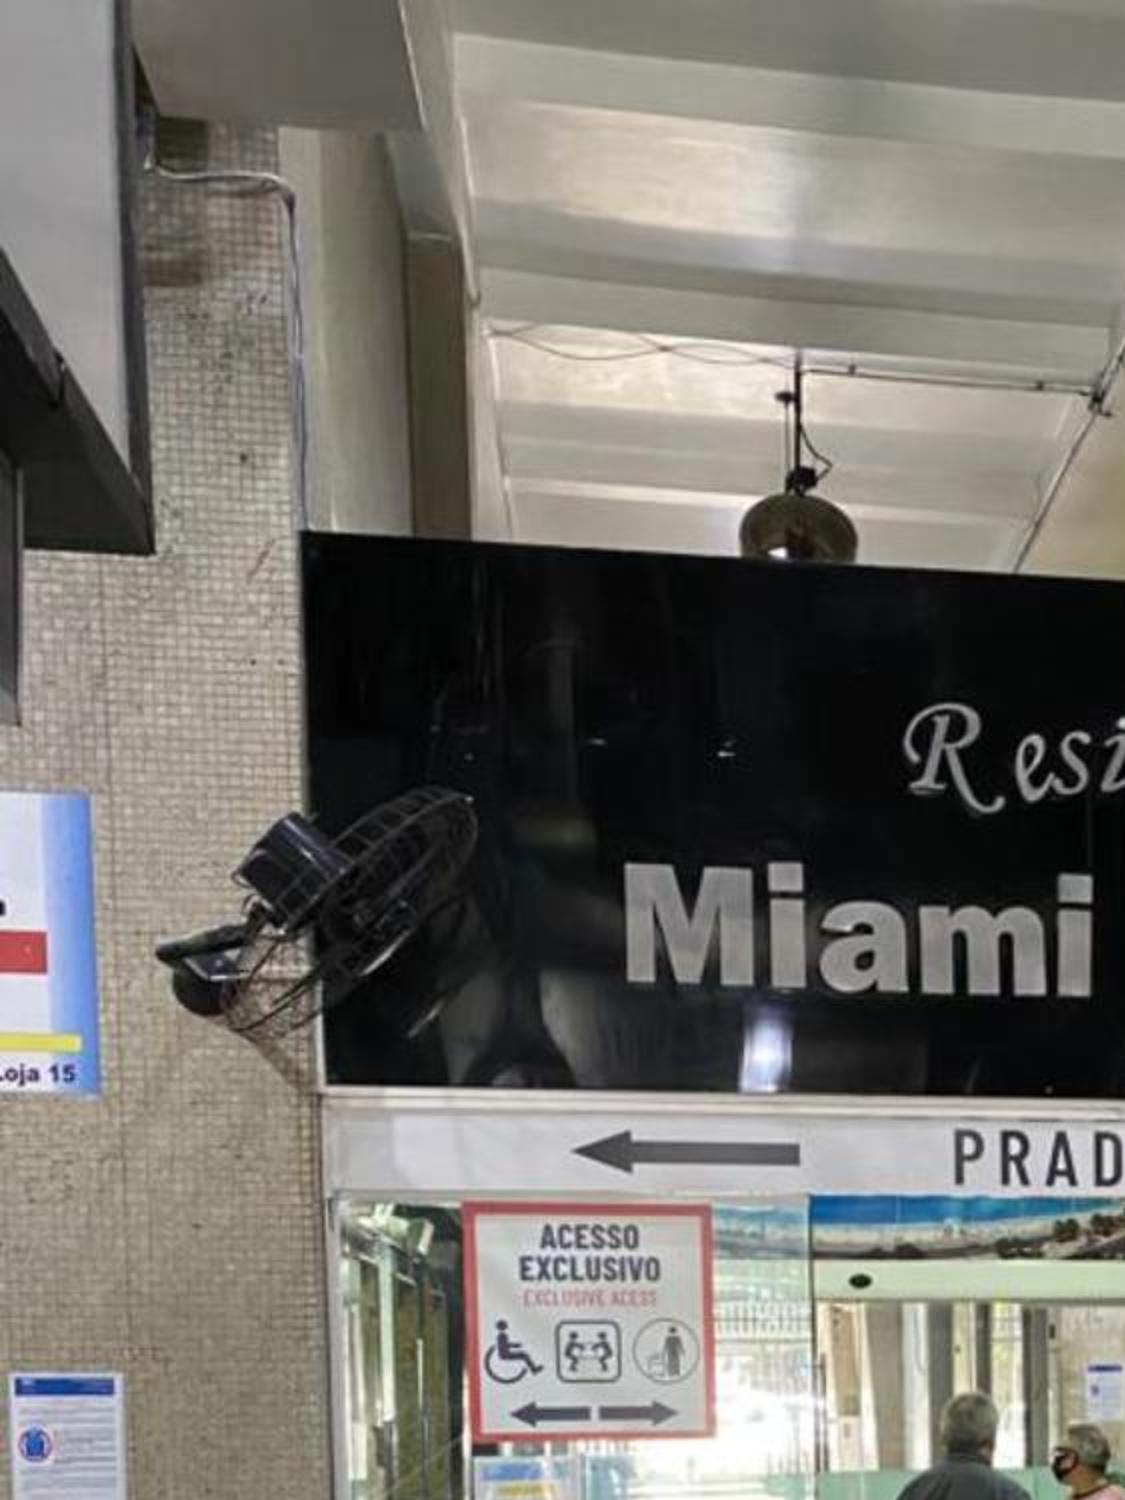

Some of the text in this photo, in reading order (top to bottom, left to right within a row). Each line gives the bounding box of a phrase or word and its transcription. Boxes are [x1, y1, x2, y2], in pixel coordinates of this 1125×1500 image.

[624, 861, 1094, 997] Miami
[0, 1063, 76, 1087] oja 15
[540, 1223, 639, 1249] ACESSO
[519, 1255, 660, 1281] EXCLUSIVO
[523, 1289, 606, 1307] EXCLUSIVE
